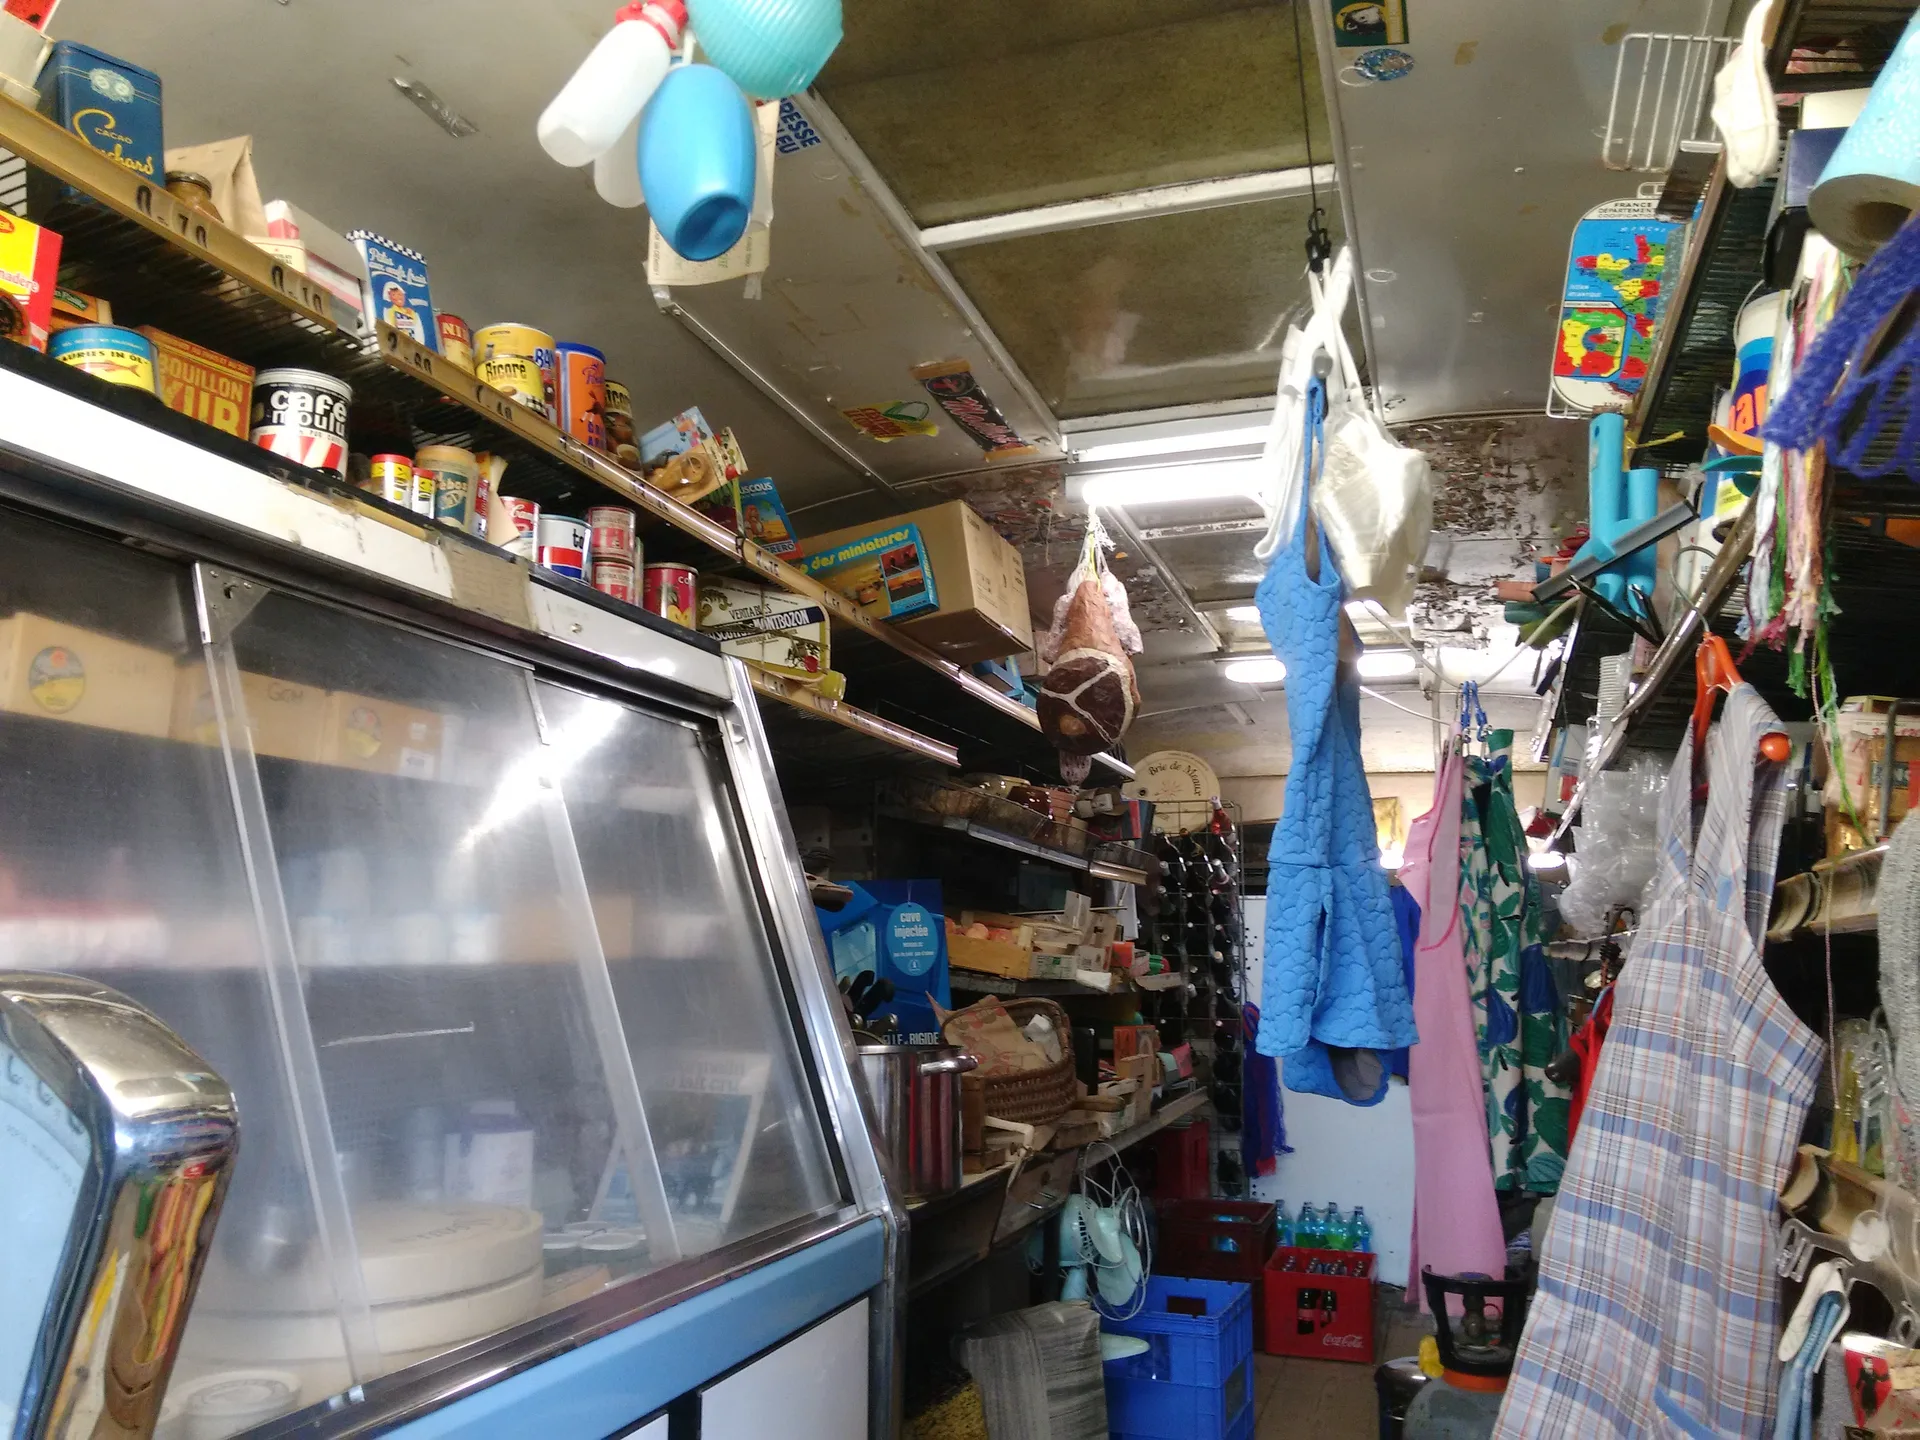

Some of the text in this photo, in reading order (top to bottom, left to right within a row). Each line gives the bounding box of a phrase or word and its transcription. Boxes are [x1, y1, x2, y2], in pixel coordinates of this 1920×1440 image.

[94, 127, 133, 145] CACAO
[158, 352, 243, 403] BOUILLON
[485, 359, 527, 384] Ricoré
[270, 389, 347, 424] café
[271, 409, 346, 437] moulu
[812, 556, 836, 570] des
[838, 528, 911, 562] miniatures
[752, 610, 811, 631] MONTBOZON
[1148, 763, 1167, 776] Brie
[1169, 760, 1182, 771] de
[1182, 764, 1202, 797] Meaux
[1322, 1333, 1364, 1349] Coca-Cola
